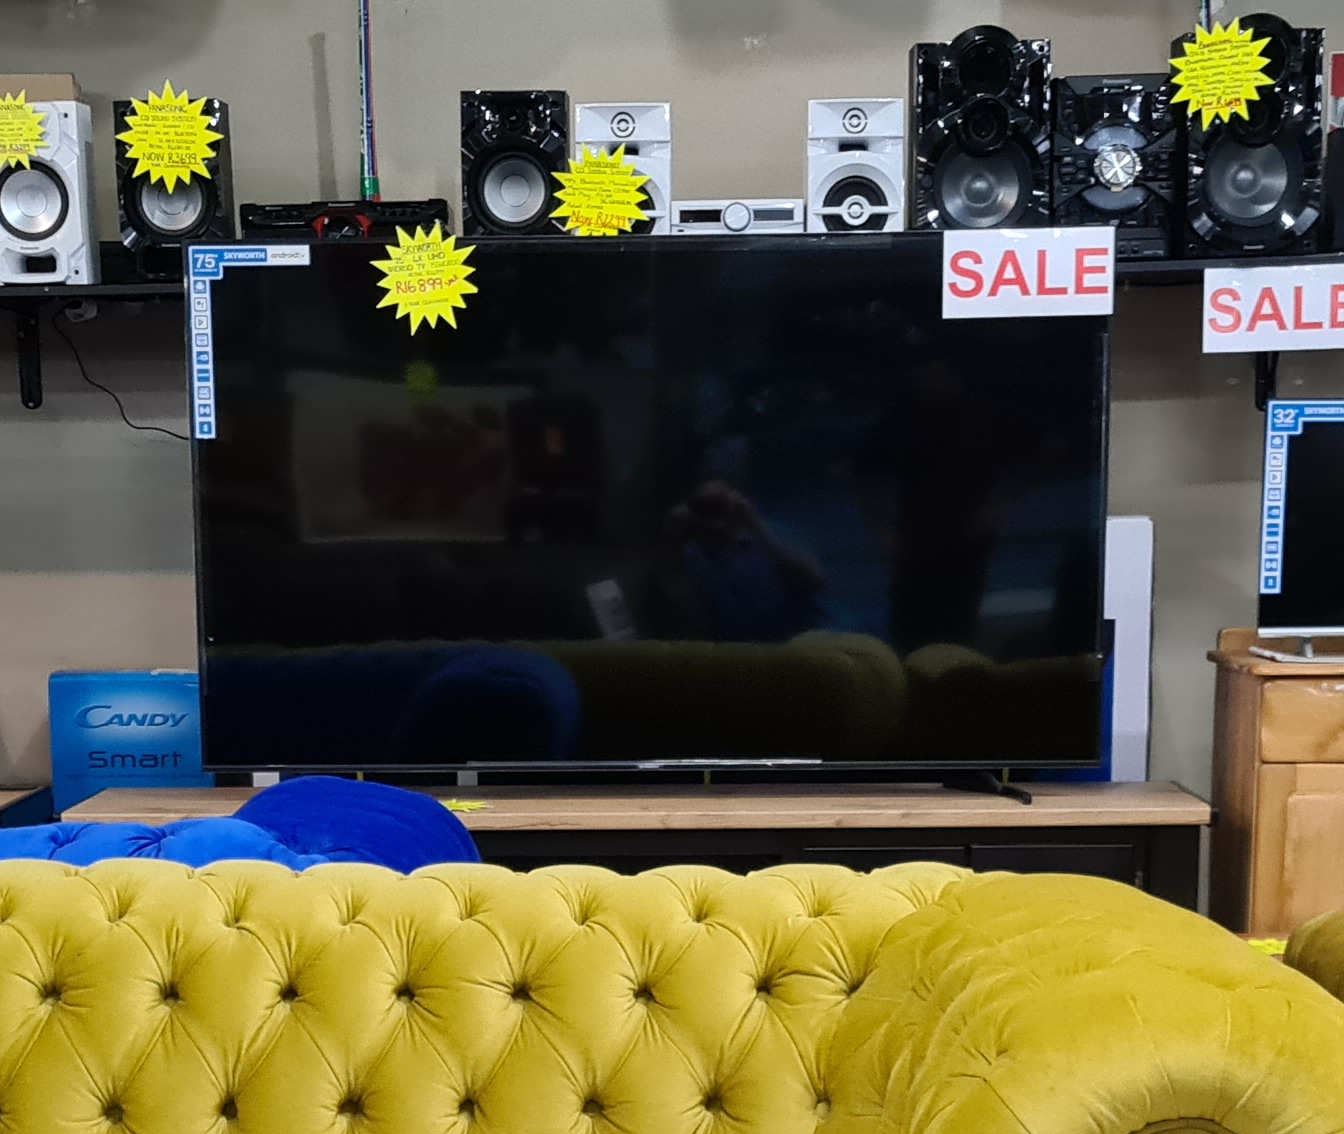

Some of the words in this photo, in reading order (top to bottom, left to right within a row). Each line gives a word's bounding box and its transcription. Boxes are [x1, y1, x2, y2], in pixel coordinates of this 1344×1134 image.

[142, 153, 164, 161] NOW
[223, 252, 266, 260] SKYWORTH
[947, 247, 1109, 299] SALE
[88, 750, 182, 769] Smart
